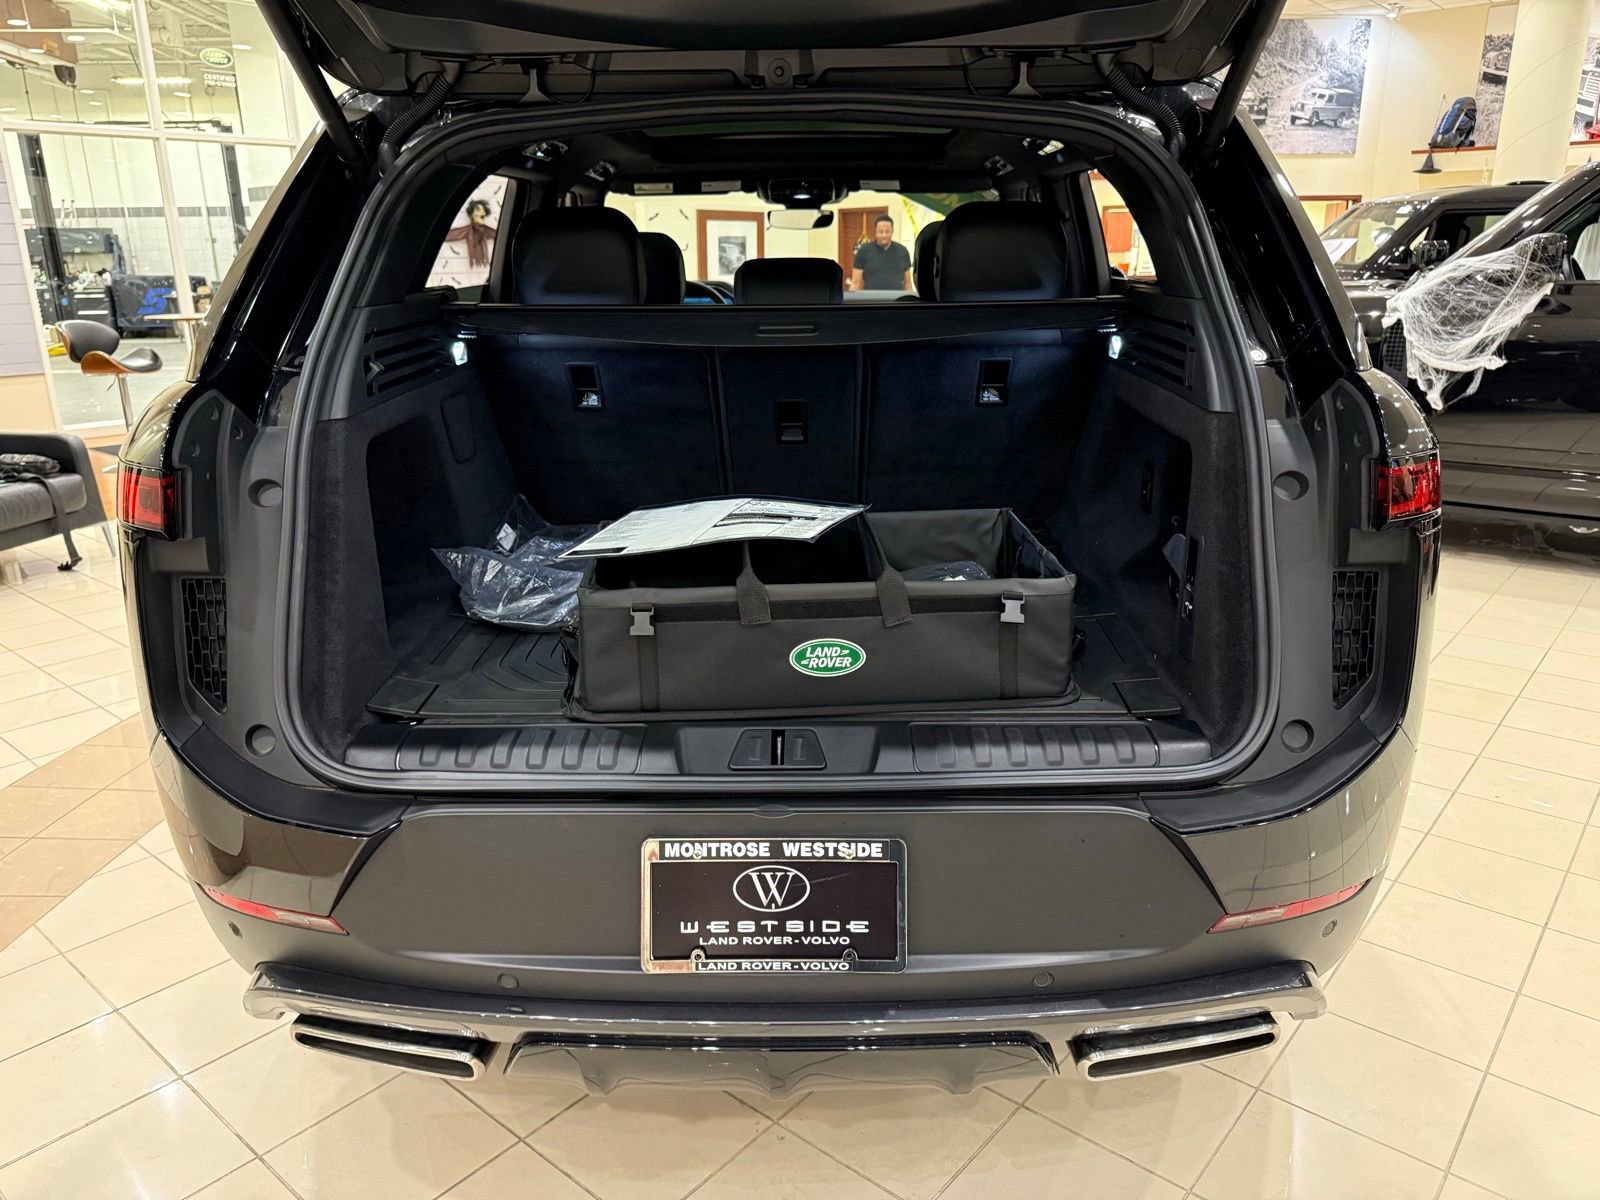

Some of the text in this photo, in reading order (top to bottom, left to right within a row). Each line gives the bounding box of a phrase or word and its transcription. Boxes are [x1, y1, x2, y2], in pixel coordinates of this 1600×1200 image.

[206, 50, 223, 58] LAND
[203, 73, 236, 82] CERTIFIED
[805, 647, 841, 657] LAND
[808, 656, 852, 668] ROVER
[664, 842, 883, 858] MONTROSE WESTSIDE
[679, 920, 870, 934] WESTSIDE
[699, 936, 738, 946] LAND
[698, 961, 737, 971] LAND
